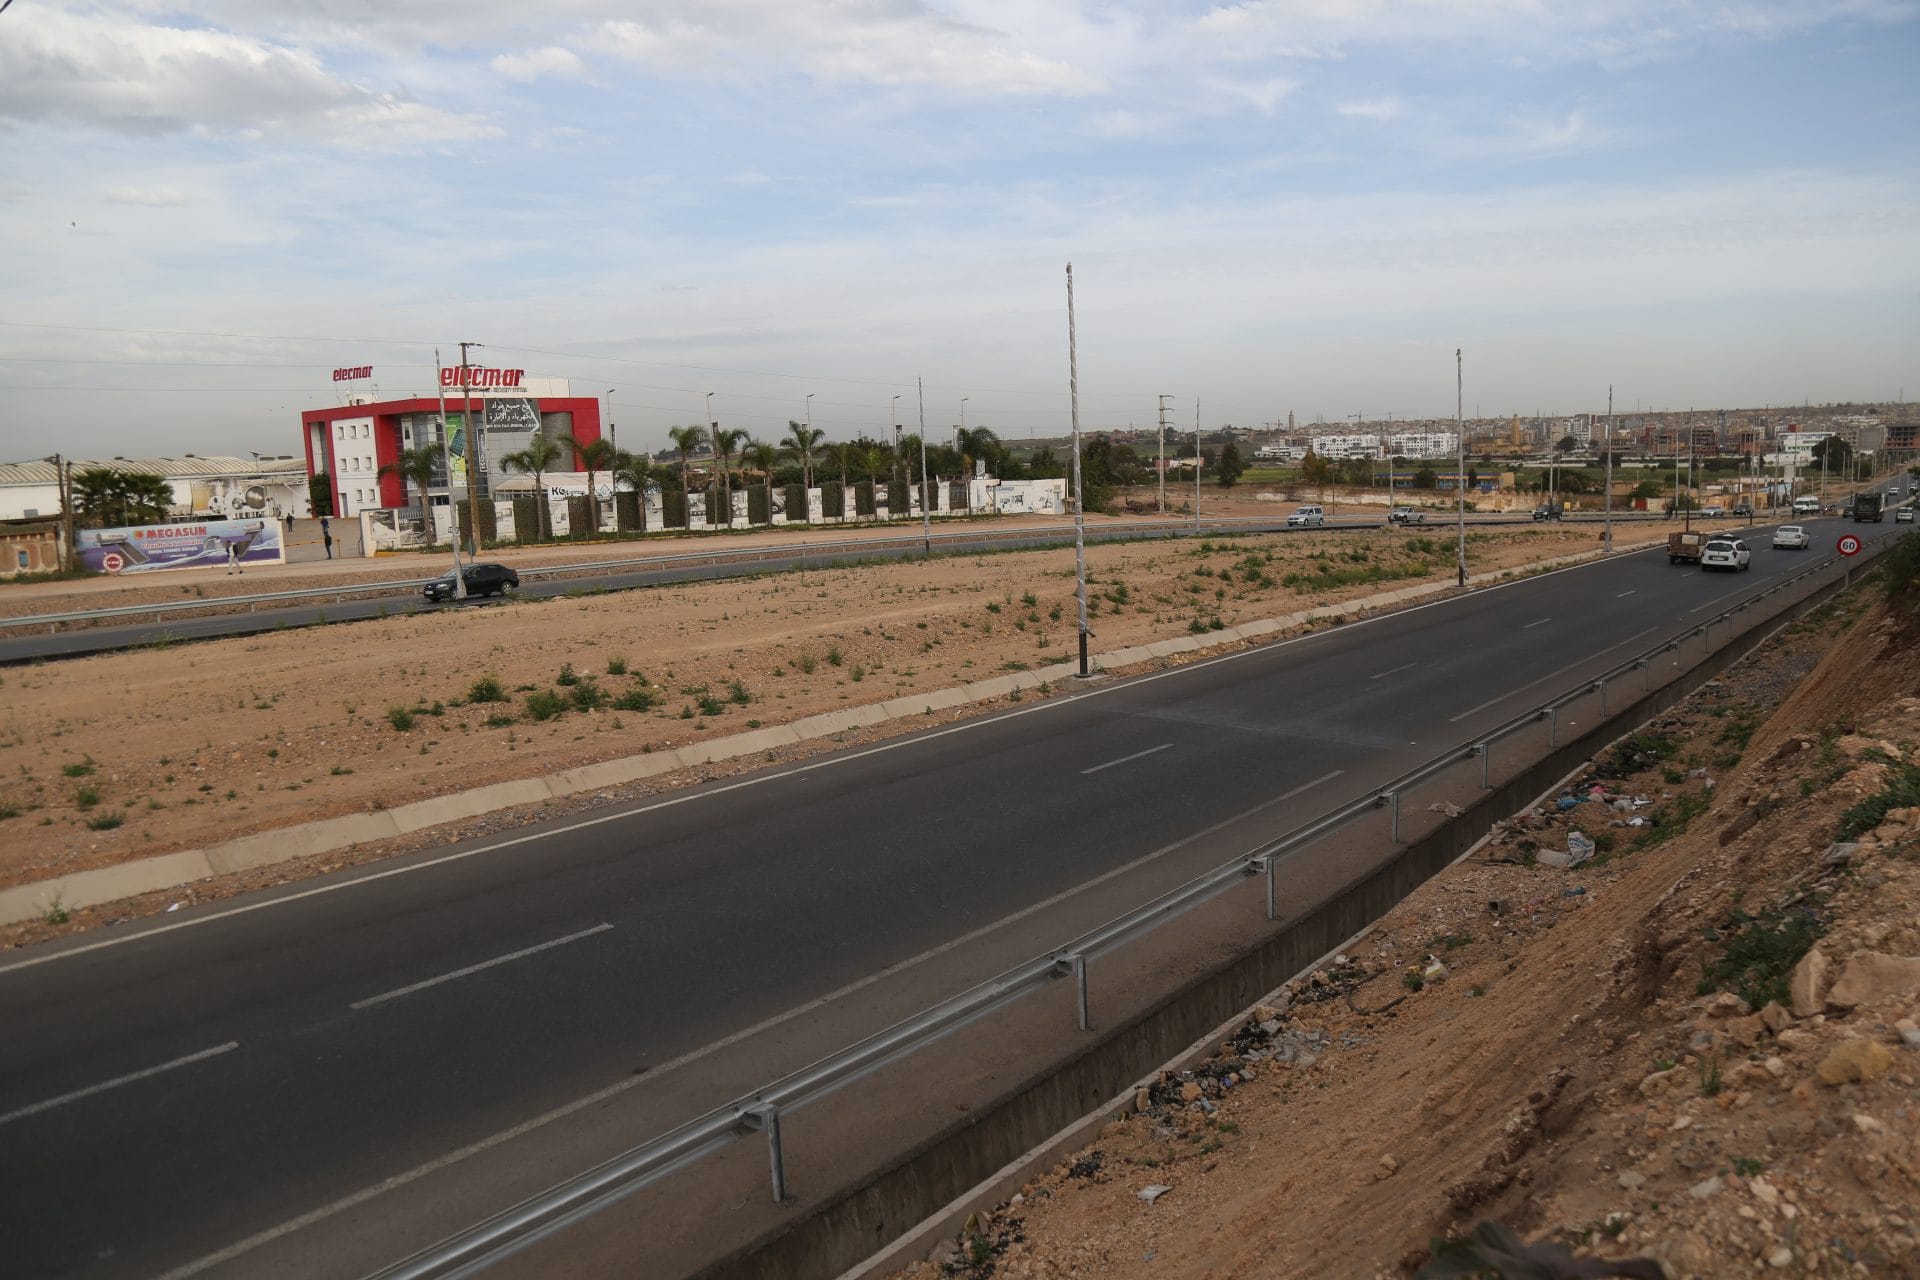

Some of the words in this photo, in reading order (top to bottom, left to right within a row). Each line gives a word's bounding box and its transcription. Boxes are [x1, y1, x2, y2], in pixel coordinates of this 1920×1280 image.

[333, 366, 373, 381] elecmar
[440, 366, 525, 387] elecmar
[146, 526, 207, 539] MEGASUN
[1842, 541, 1856, 550] 60
